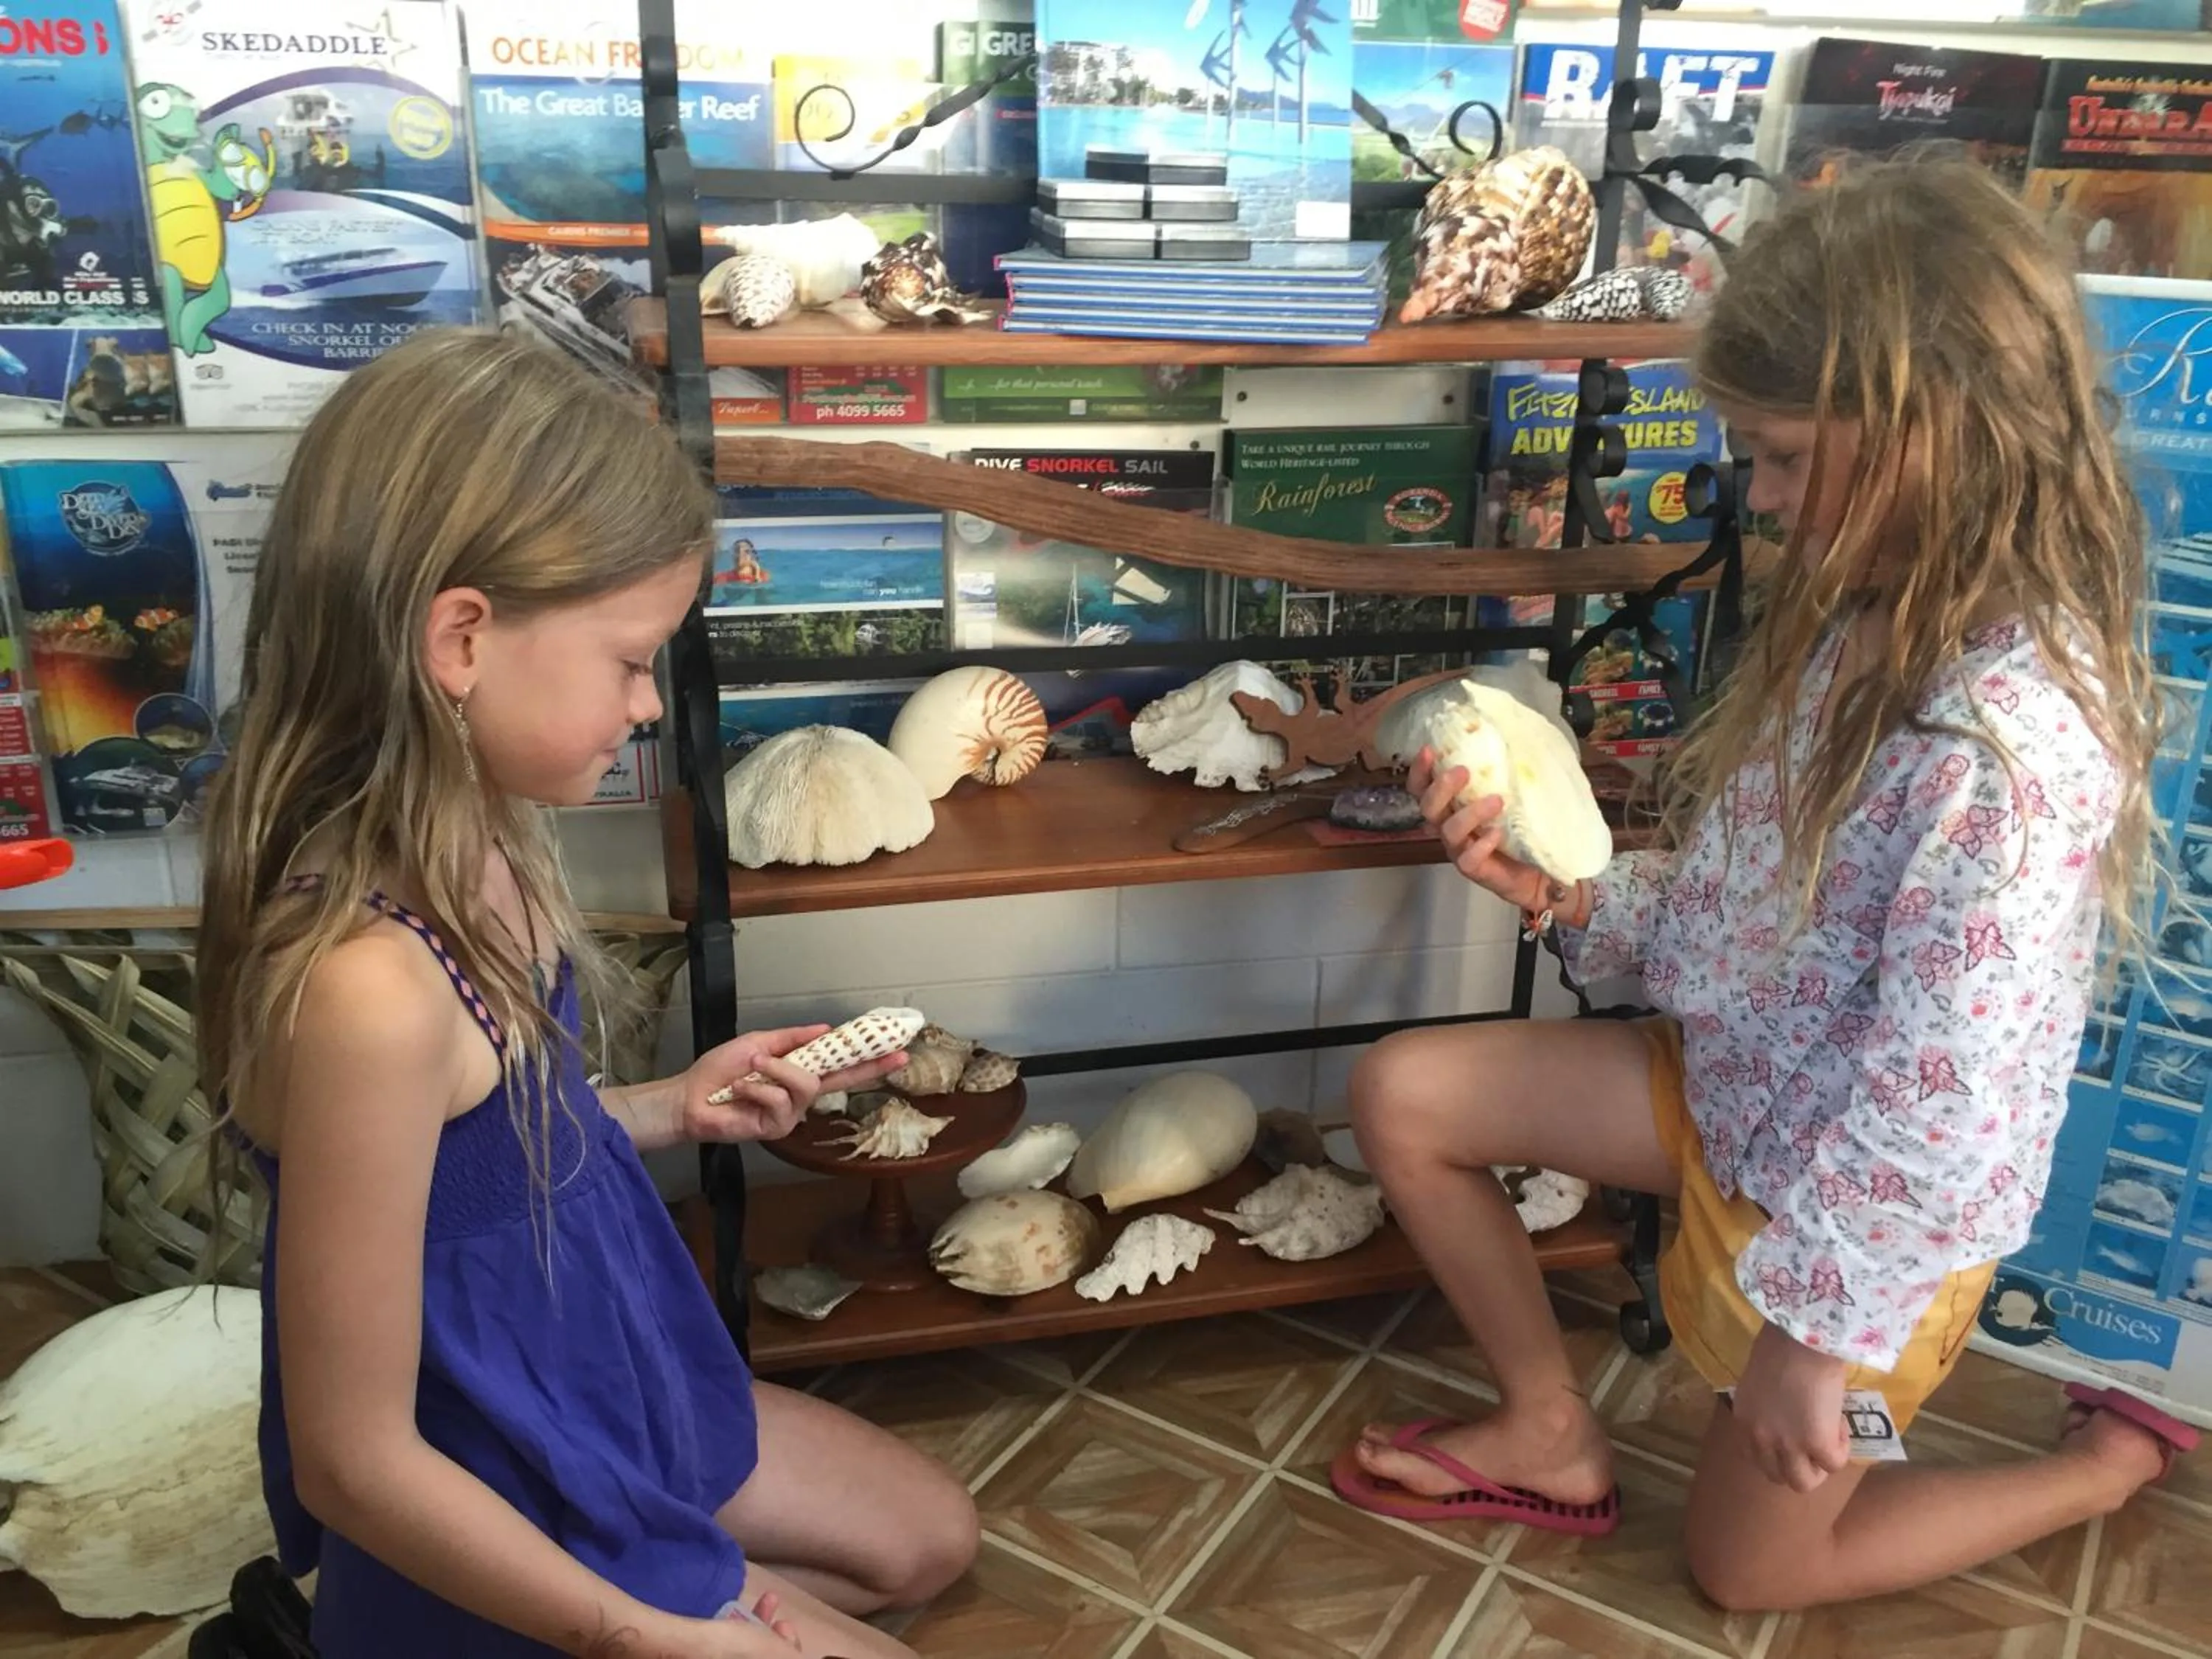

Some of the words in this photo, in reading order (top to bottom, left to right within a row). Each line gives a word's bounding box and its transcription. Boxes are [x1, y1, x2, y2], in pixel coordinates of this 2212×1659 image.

[202, 32, 388, 55] SKEDADDLE
[493, 37, 595, 67] OCEAN
[479, 88, 531, 115] The
[535, 90, 608, 117] Great
[614, 92, 697, 121] Baer
[702, 94, 762, 122] Reef
[63, 291, 125, 305] CLASS
[251, 322, 317, 333] CHECK
[324, 322, 344, 333] IN
[350, 323, 375, 334] AT
[288, 335, 375, 346] SNORKEL
[816, 405, 833, 420] ph
[837, 404, 869, 417] 4099
[872, 404, 905, 417] 5665
[1027, 457, 1119, 473] SNORKEL
[1125, 459, 1168, 474] SAIL
[1251, 472, 1379, 518] Rainforest
[2043, 1287, 2162, 1345] Cruises
